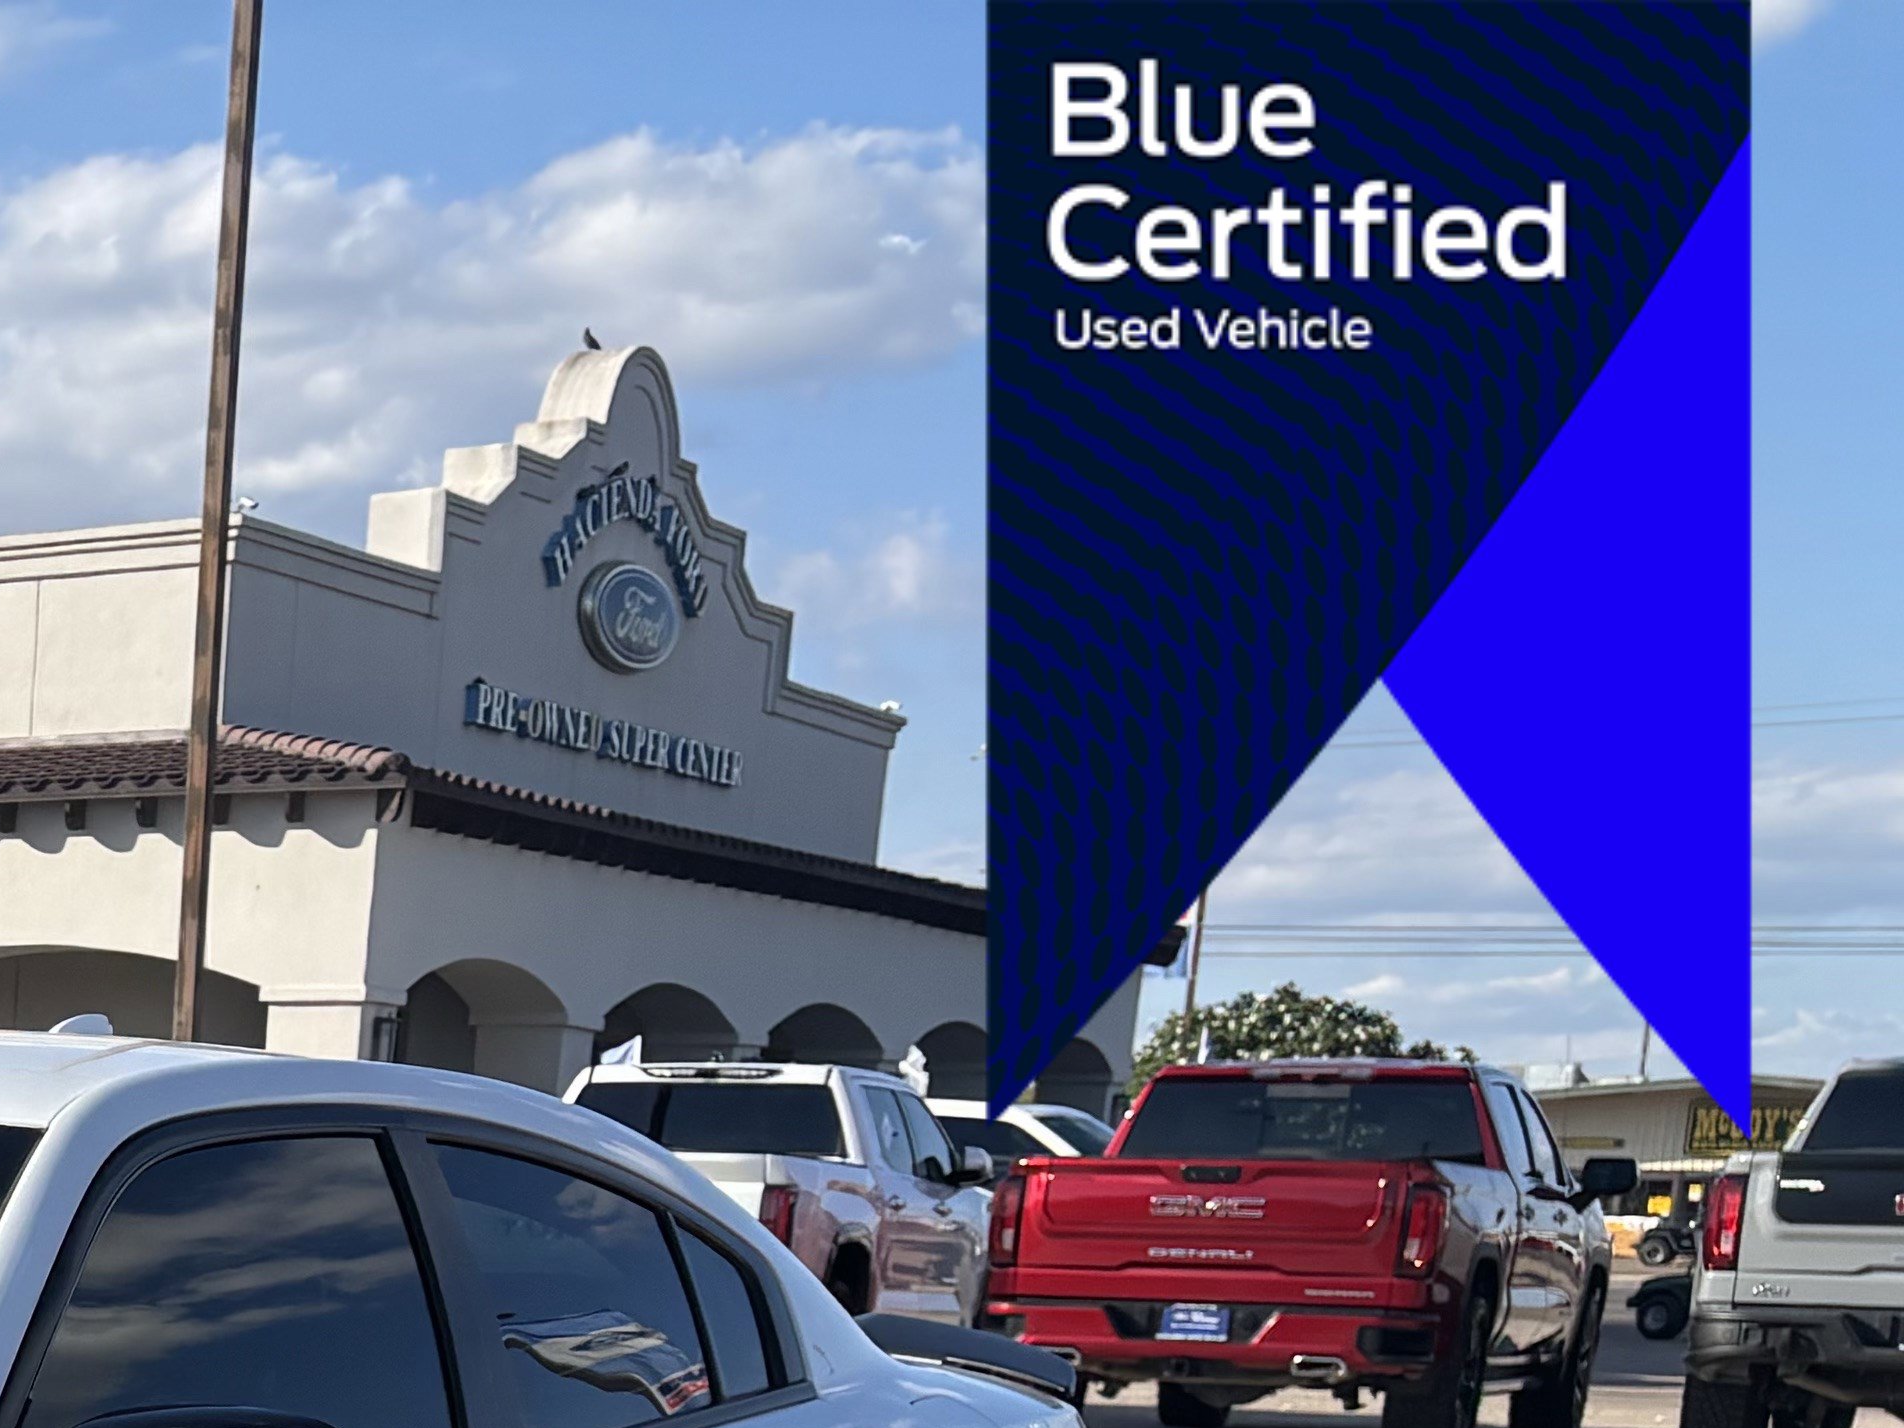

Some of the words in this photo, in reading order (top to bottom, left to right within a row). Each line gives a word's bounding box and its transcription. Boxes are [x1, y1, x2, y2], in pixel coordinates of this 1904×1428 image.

[552, 477, 663, 584] HACIENDA
[663, 507, 707, 616] FORD
[616, 586, 668, 649] Ford
[476, 683, 603, 752] PRE-OWNED
[608, 719, 670, 770] SUPER
[674, 736, 743, 786] CENTER
[1149, 1195, 1267, 1220] GMC
[1147, 1246, 1254, 1260] DENALI
